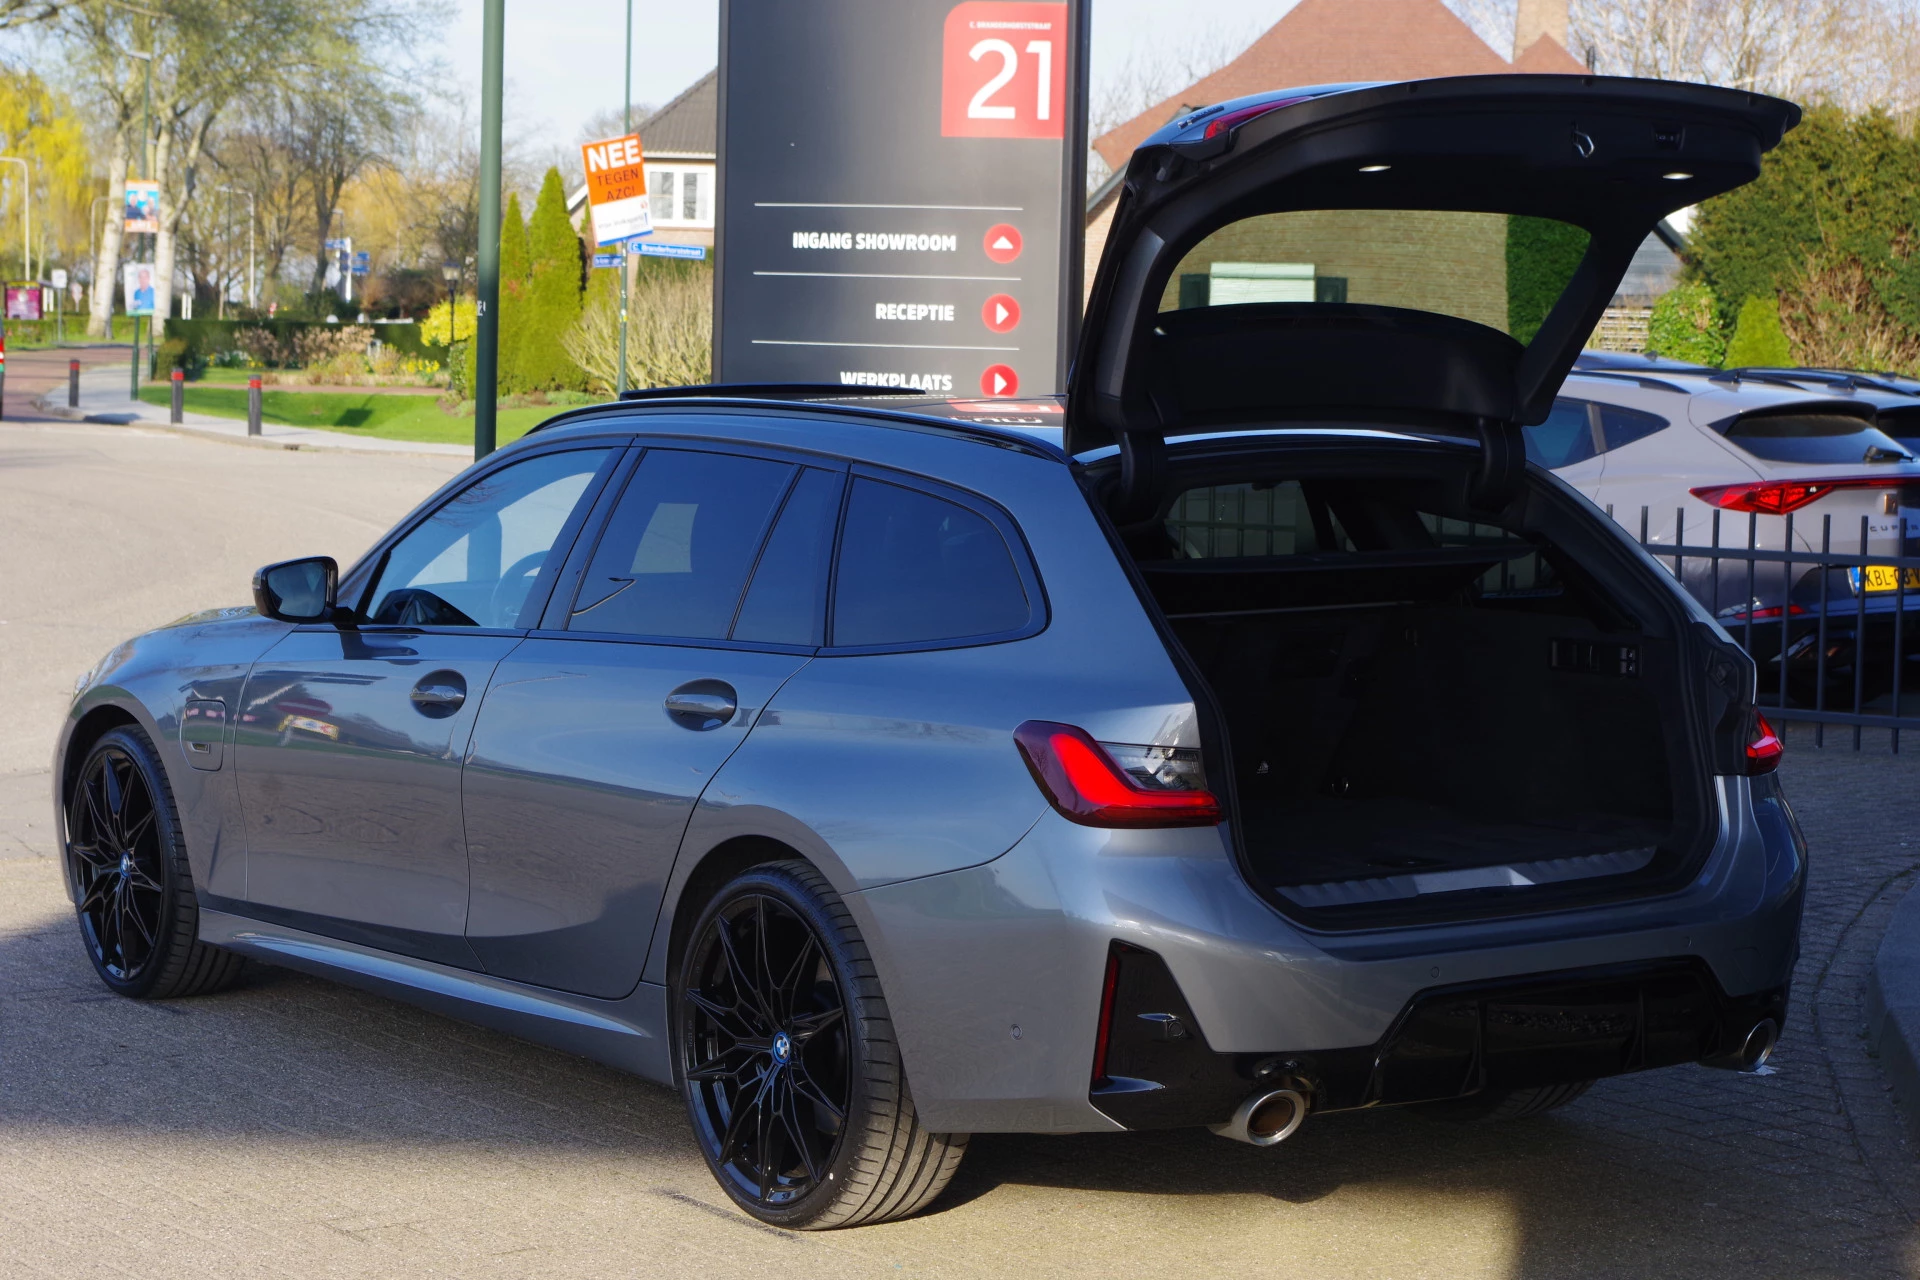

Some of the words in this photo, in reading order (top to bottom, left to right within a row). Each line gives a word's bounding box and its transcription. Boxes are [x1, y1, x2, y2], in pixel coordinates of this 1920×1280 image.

[968, 38, 1052, 120] 21
[587, 138, 641, 172] NEE
[597, 168, 639, 186] TEGEN
[606, 186, 635, 202] AZC!
[793, 232, 852, 249] INGANG
[856, 233, 956, 251] SHOWROOM
[875, 303, 954, 321] RECEPTIE
[840, 371, 952, 391] WERKPLAATS
[1869, 524, 1919, 532] CUPA
